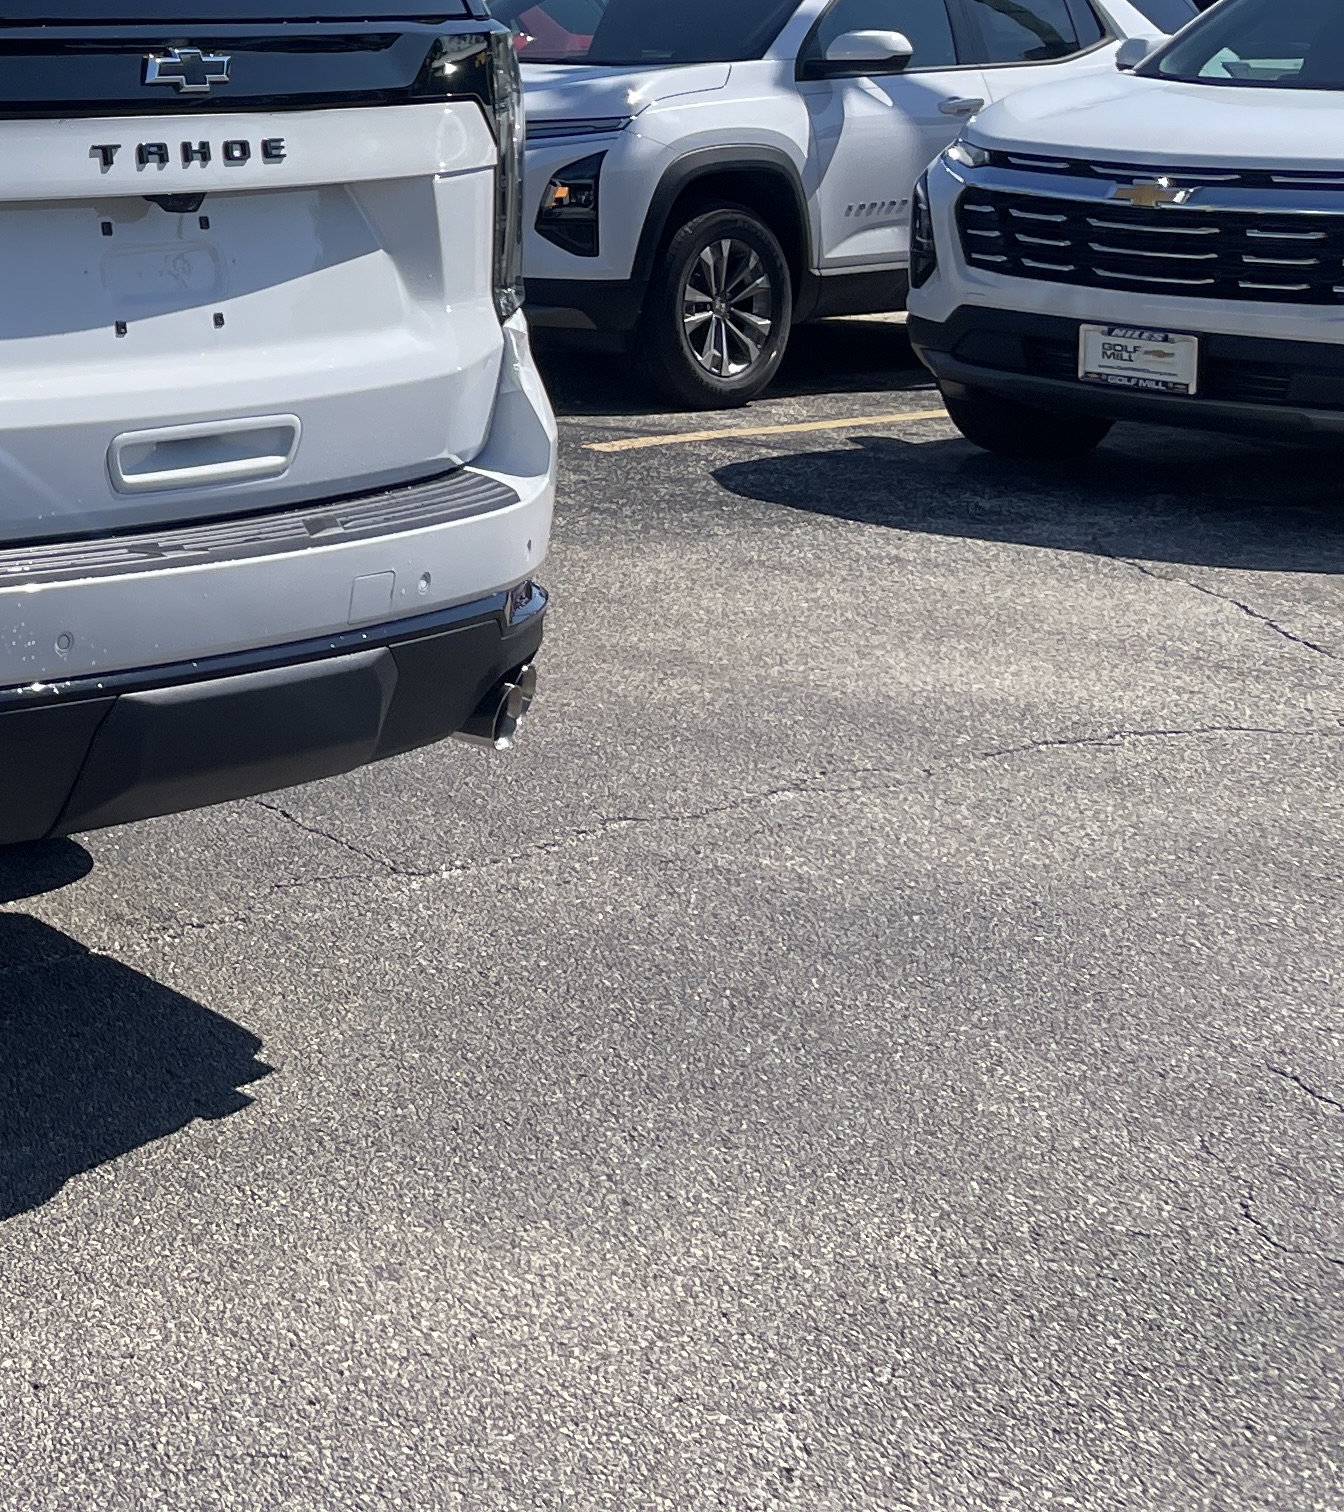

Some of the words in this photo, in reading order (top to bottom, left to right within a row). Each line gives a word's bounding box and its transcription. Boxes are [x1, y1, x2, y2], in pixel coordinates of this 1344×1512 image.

[90, 137, 288, 168] TAHOE
[1111, 328, 1166, 342] NILES
[1101, 342, 1142, 353] GOLF
[1101, 351, 1135, 363] MILL
[1107, 374, 1137, 386] GOLF
[1138, 378, 1167, 390] MILL
